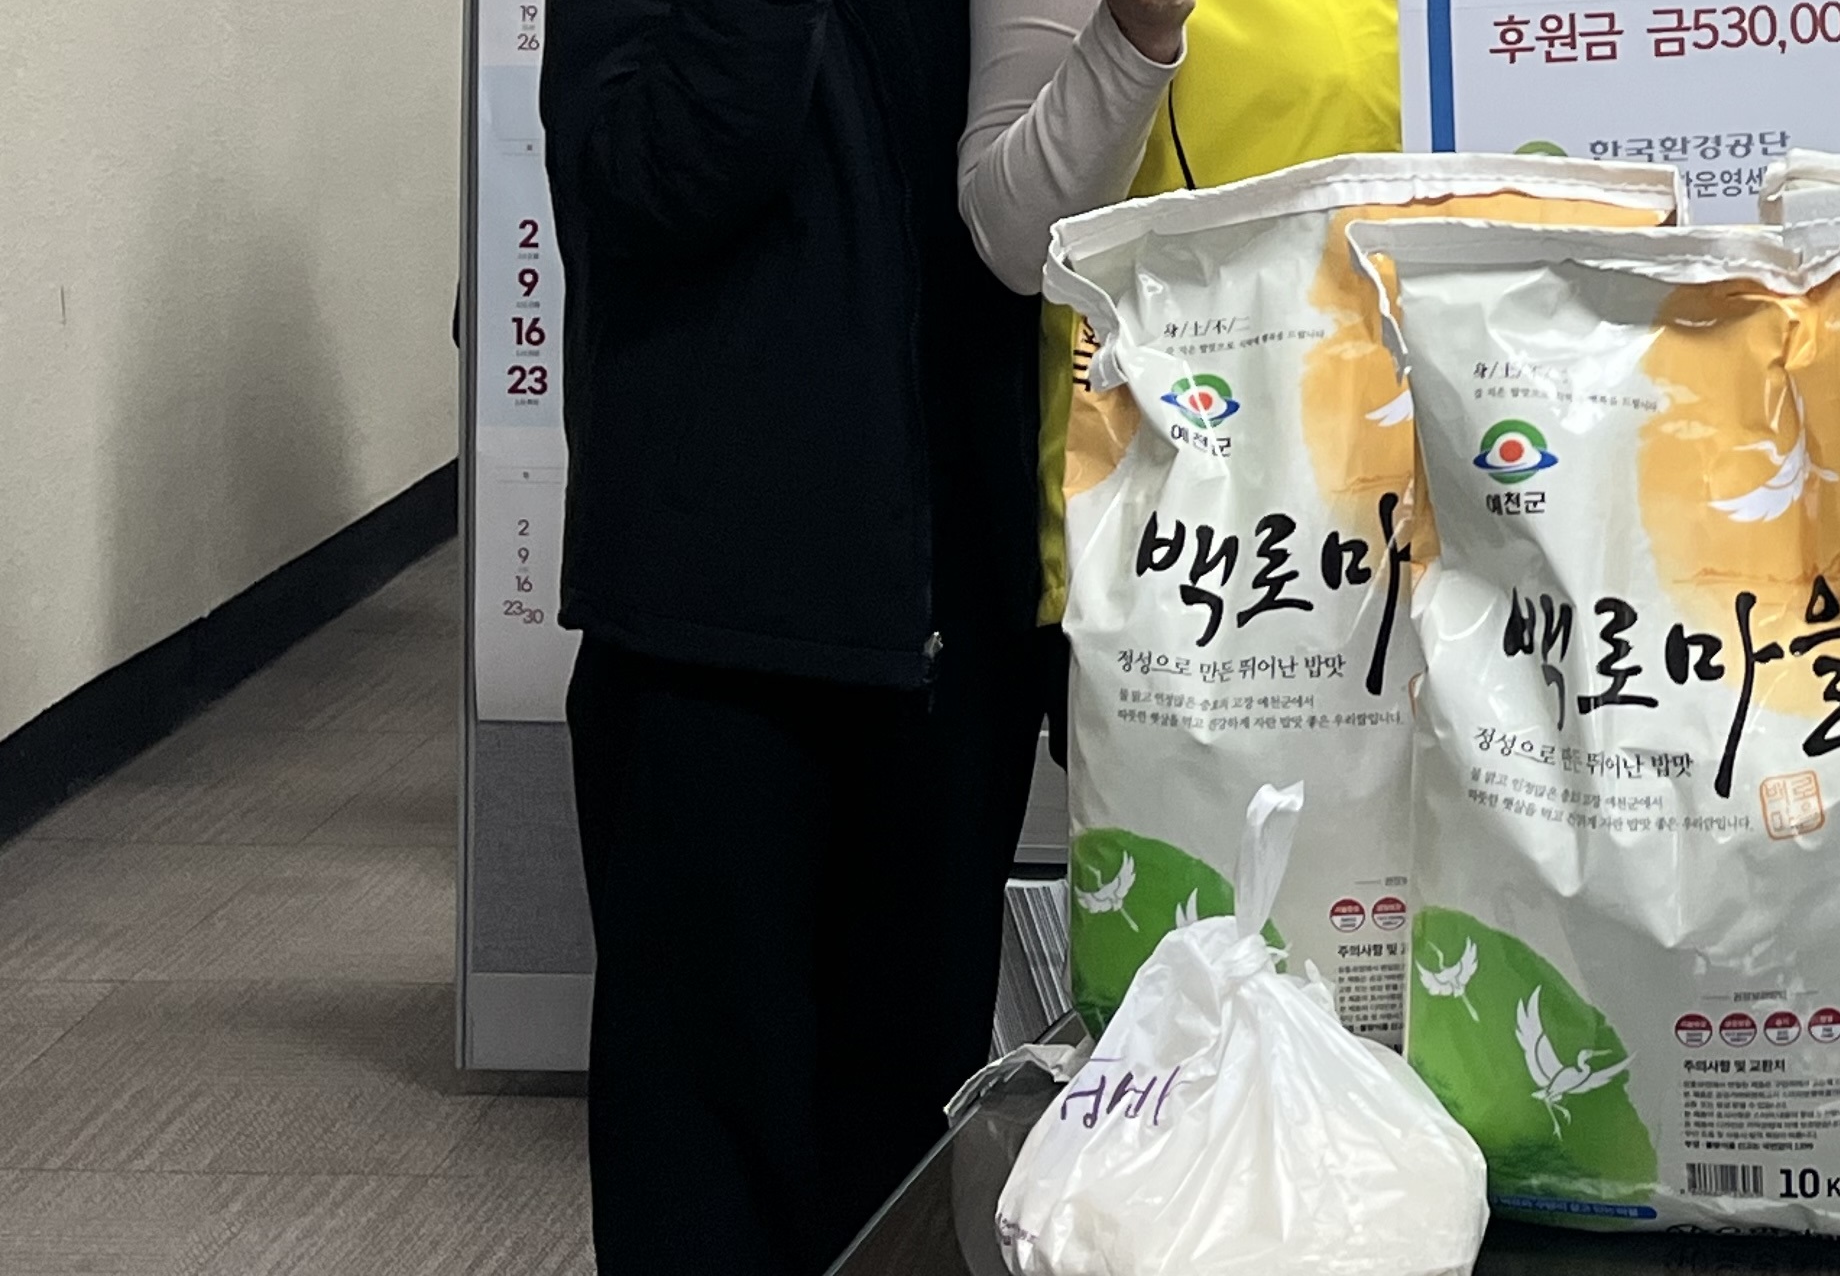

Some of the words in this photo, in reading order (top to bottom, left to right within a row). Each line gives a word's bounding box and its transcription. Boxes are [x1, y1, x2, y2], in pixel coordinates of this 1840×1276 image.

[520, 5, 538, 22] 19
[517, 33, 540, 51] 26
[1489, 11, 1624, 64] 후원금
[1589, 130, 1790, 162] 한국환경공단
[518, 219, 539, 249] 2
[517, 268, 539, 297] 9
[511, 317, 546, 347] 16
[507, 365, 548, 395] 23
[1170, 423, 1231, 457] 예천군
[1486, 491, 1546, 516] 예천군
[518, 519, 530, 536] 2
[518, 547, 530, 564] 9
[516, 575, 533, 593] 16
[503, 600, 524, 616] 23
[523, 609, 545, 624] 30
[1117, 649, 1191, 675] 정성으로
[1200, 658, 1232, 683] 만든
[1239, 655, 1298, 680] 뛰어난
[1304, 653, 1347, 679] 밥맛
[1474, 726, 1555, 766] 정성으로
[1586, 752, 1644, 779] 뛰어난
[1651, 753, 1694, 779] 밥맛
[1683, 1058, 1731, 1073] 주의사항
[1734, 1060, 1746, 1073] 및
[1780, 1168, 1820, 1199] 10
